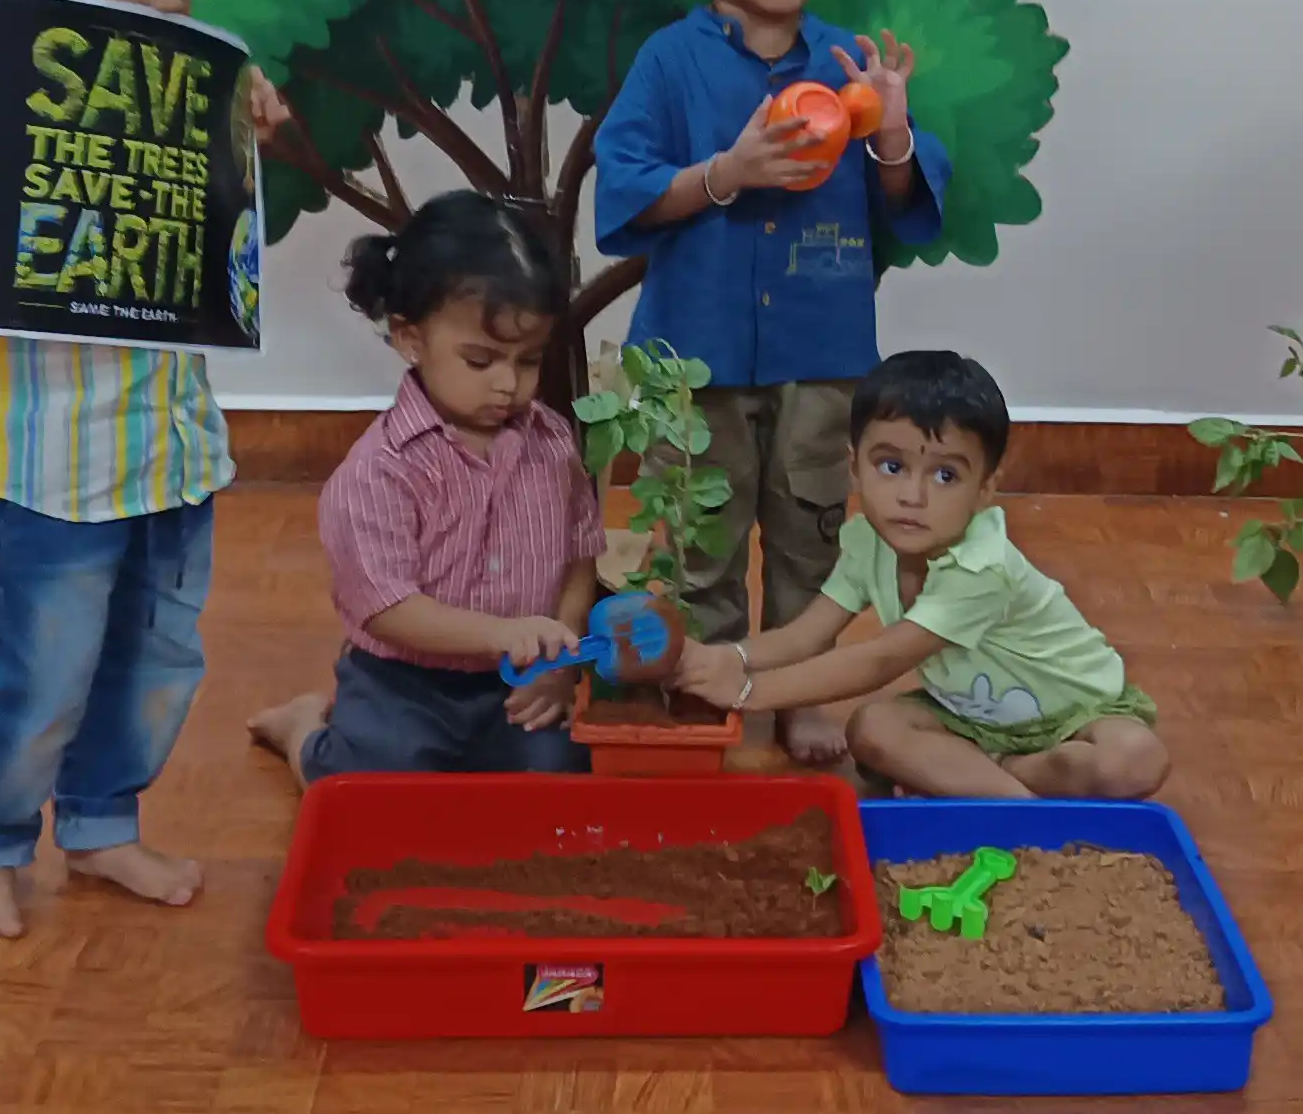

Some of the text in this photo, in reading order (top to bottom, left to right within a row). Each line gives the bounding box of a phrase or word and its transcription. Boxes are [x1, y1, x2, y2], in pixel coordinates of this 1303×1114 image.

[25, 26, 213, 149] SAVE
[26, 123, 210, 185] THE TREES
[12, 200, 205, 309] EARTH
